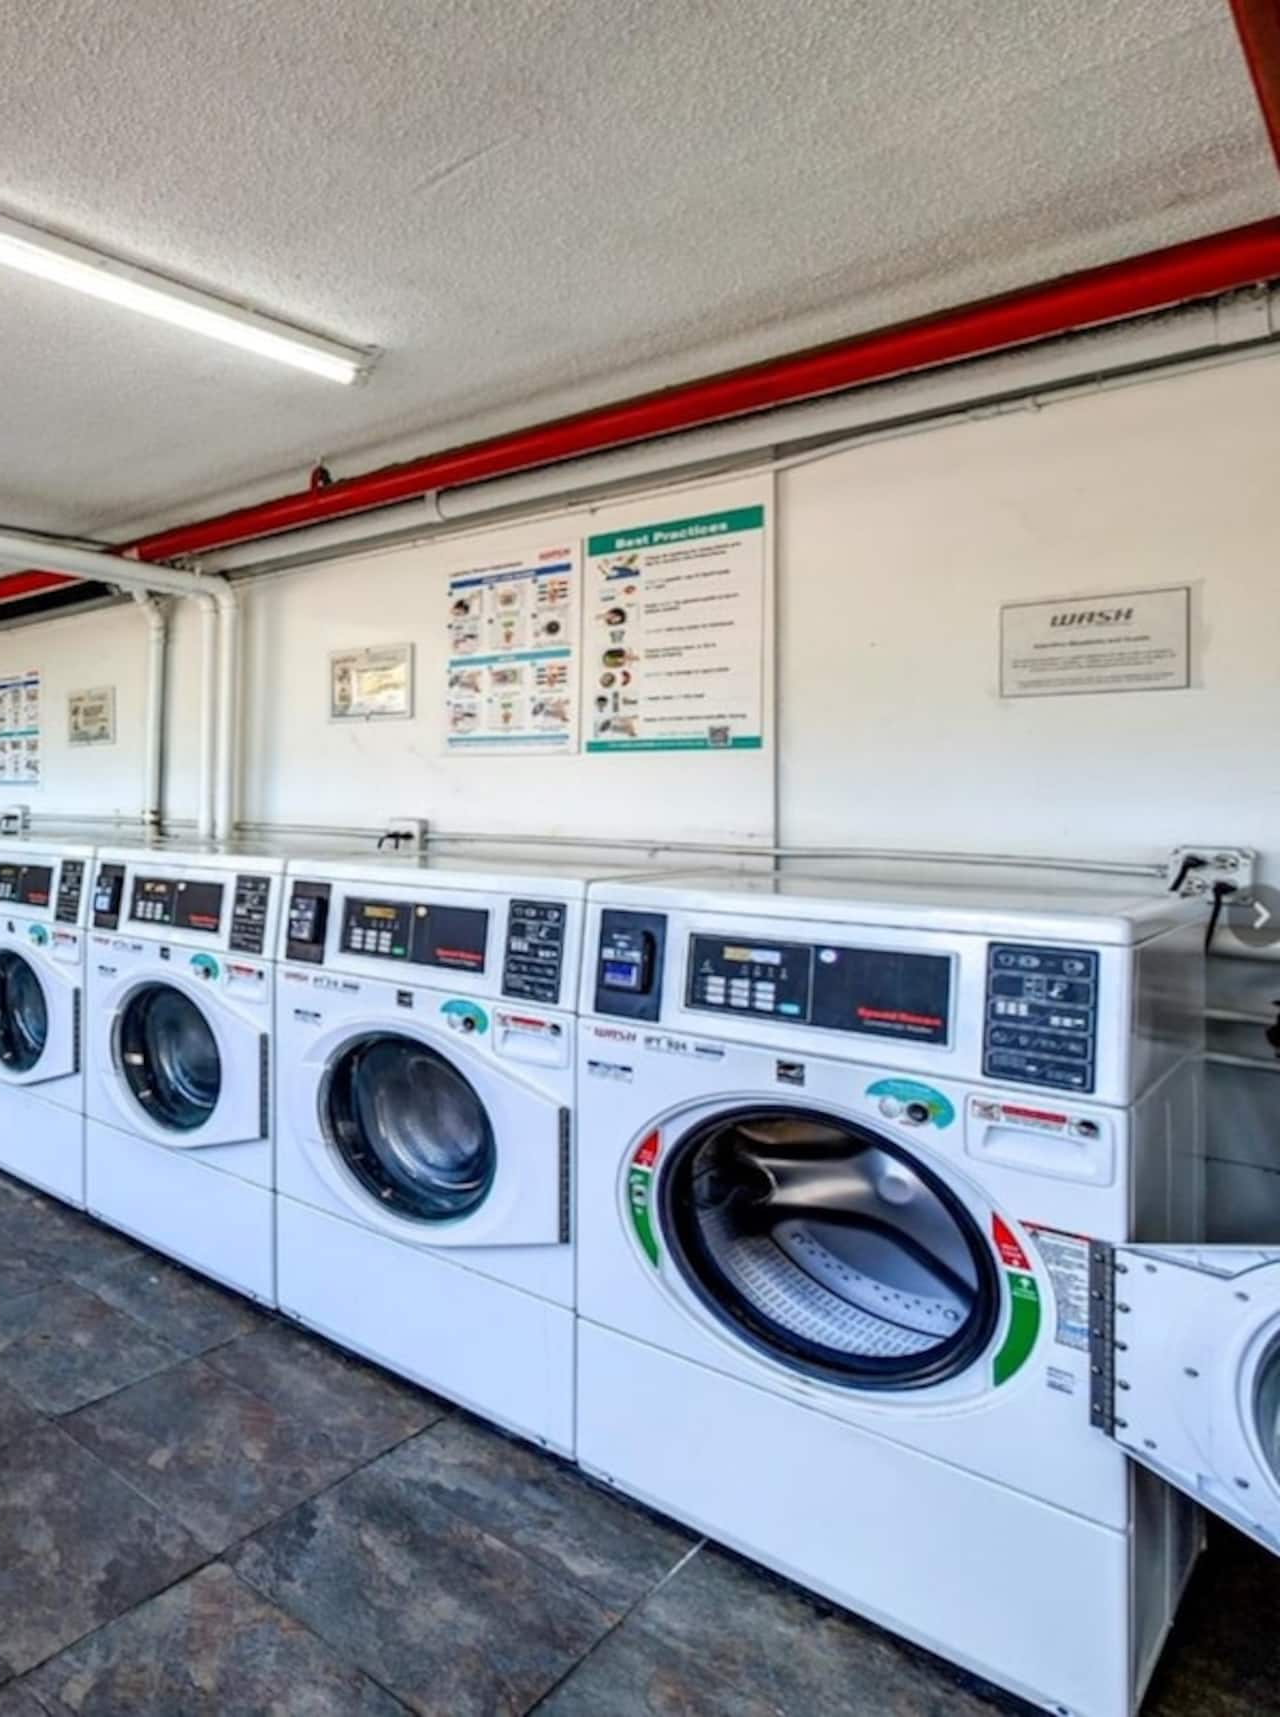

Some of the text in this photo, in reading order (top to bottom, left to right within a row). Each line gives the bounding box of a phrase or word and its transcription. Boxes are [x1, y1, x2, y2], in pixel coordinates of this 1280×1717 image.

[615, 521, 729, 549] Best Practices
[1050, 607, 1135, 627] WASH
